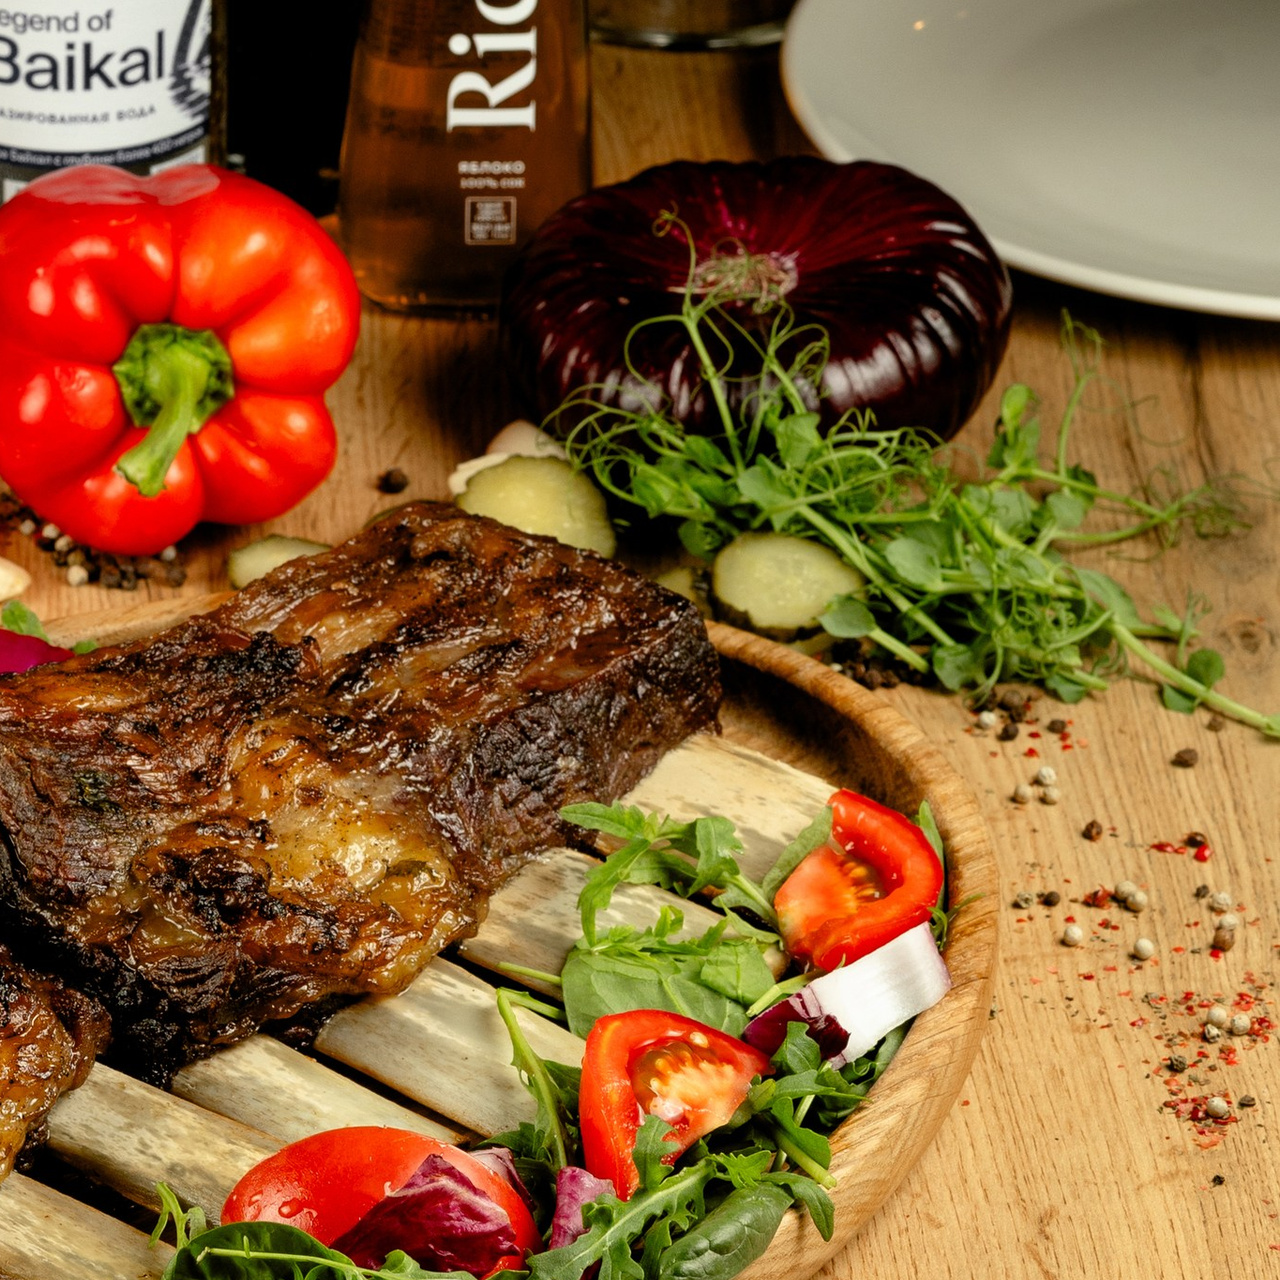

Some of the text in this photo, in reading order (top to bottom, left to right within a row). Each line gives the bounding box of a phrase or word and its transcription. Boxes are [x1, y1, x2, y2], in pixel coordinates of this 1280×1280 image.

[86, 8, 114, 32] of
[115, 103, 157, 122] ВОДА
[458, 160, 526, 175] ЯБЛОКО
